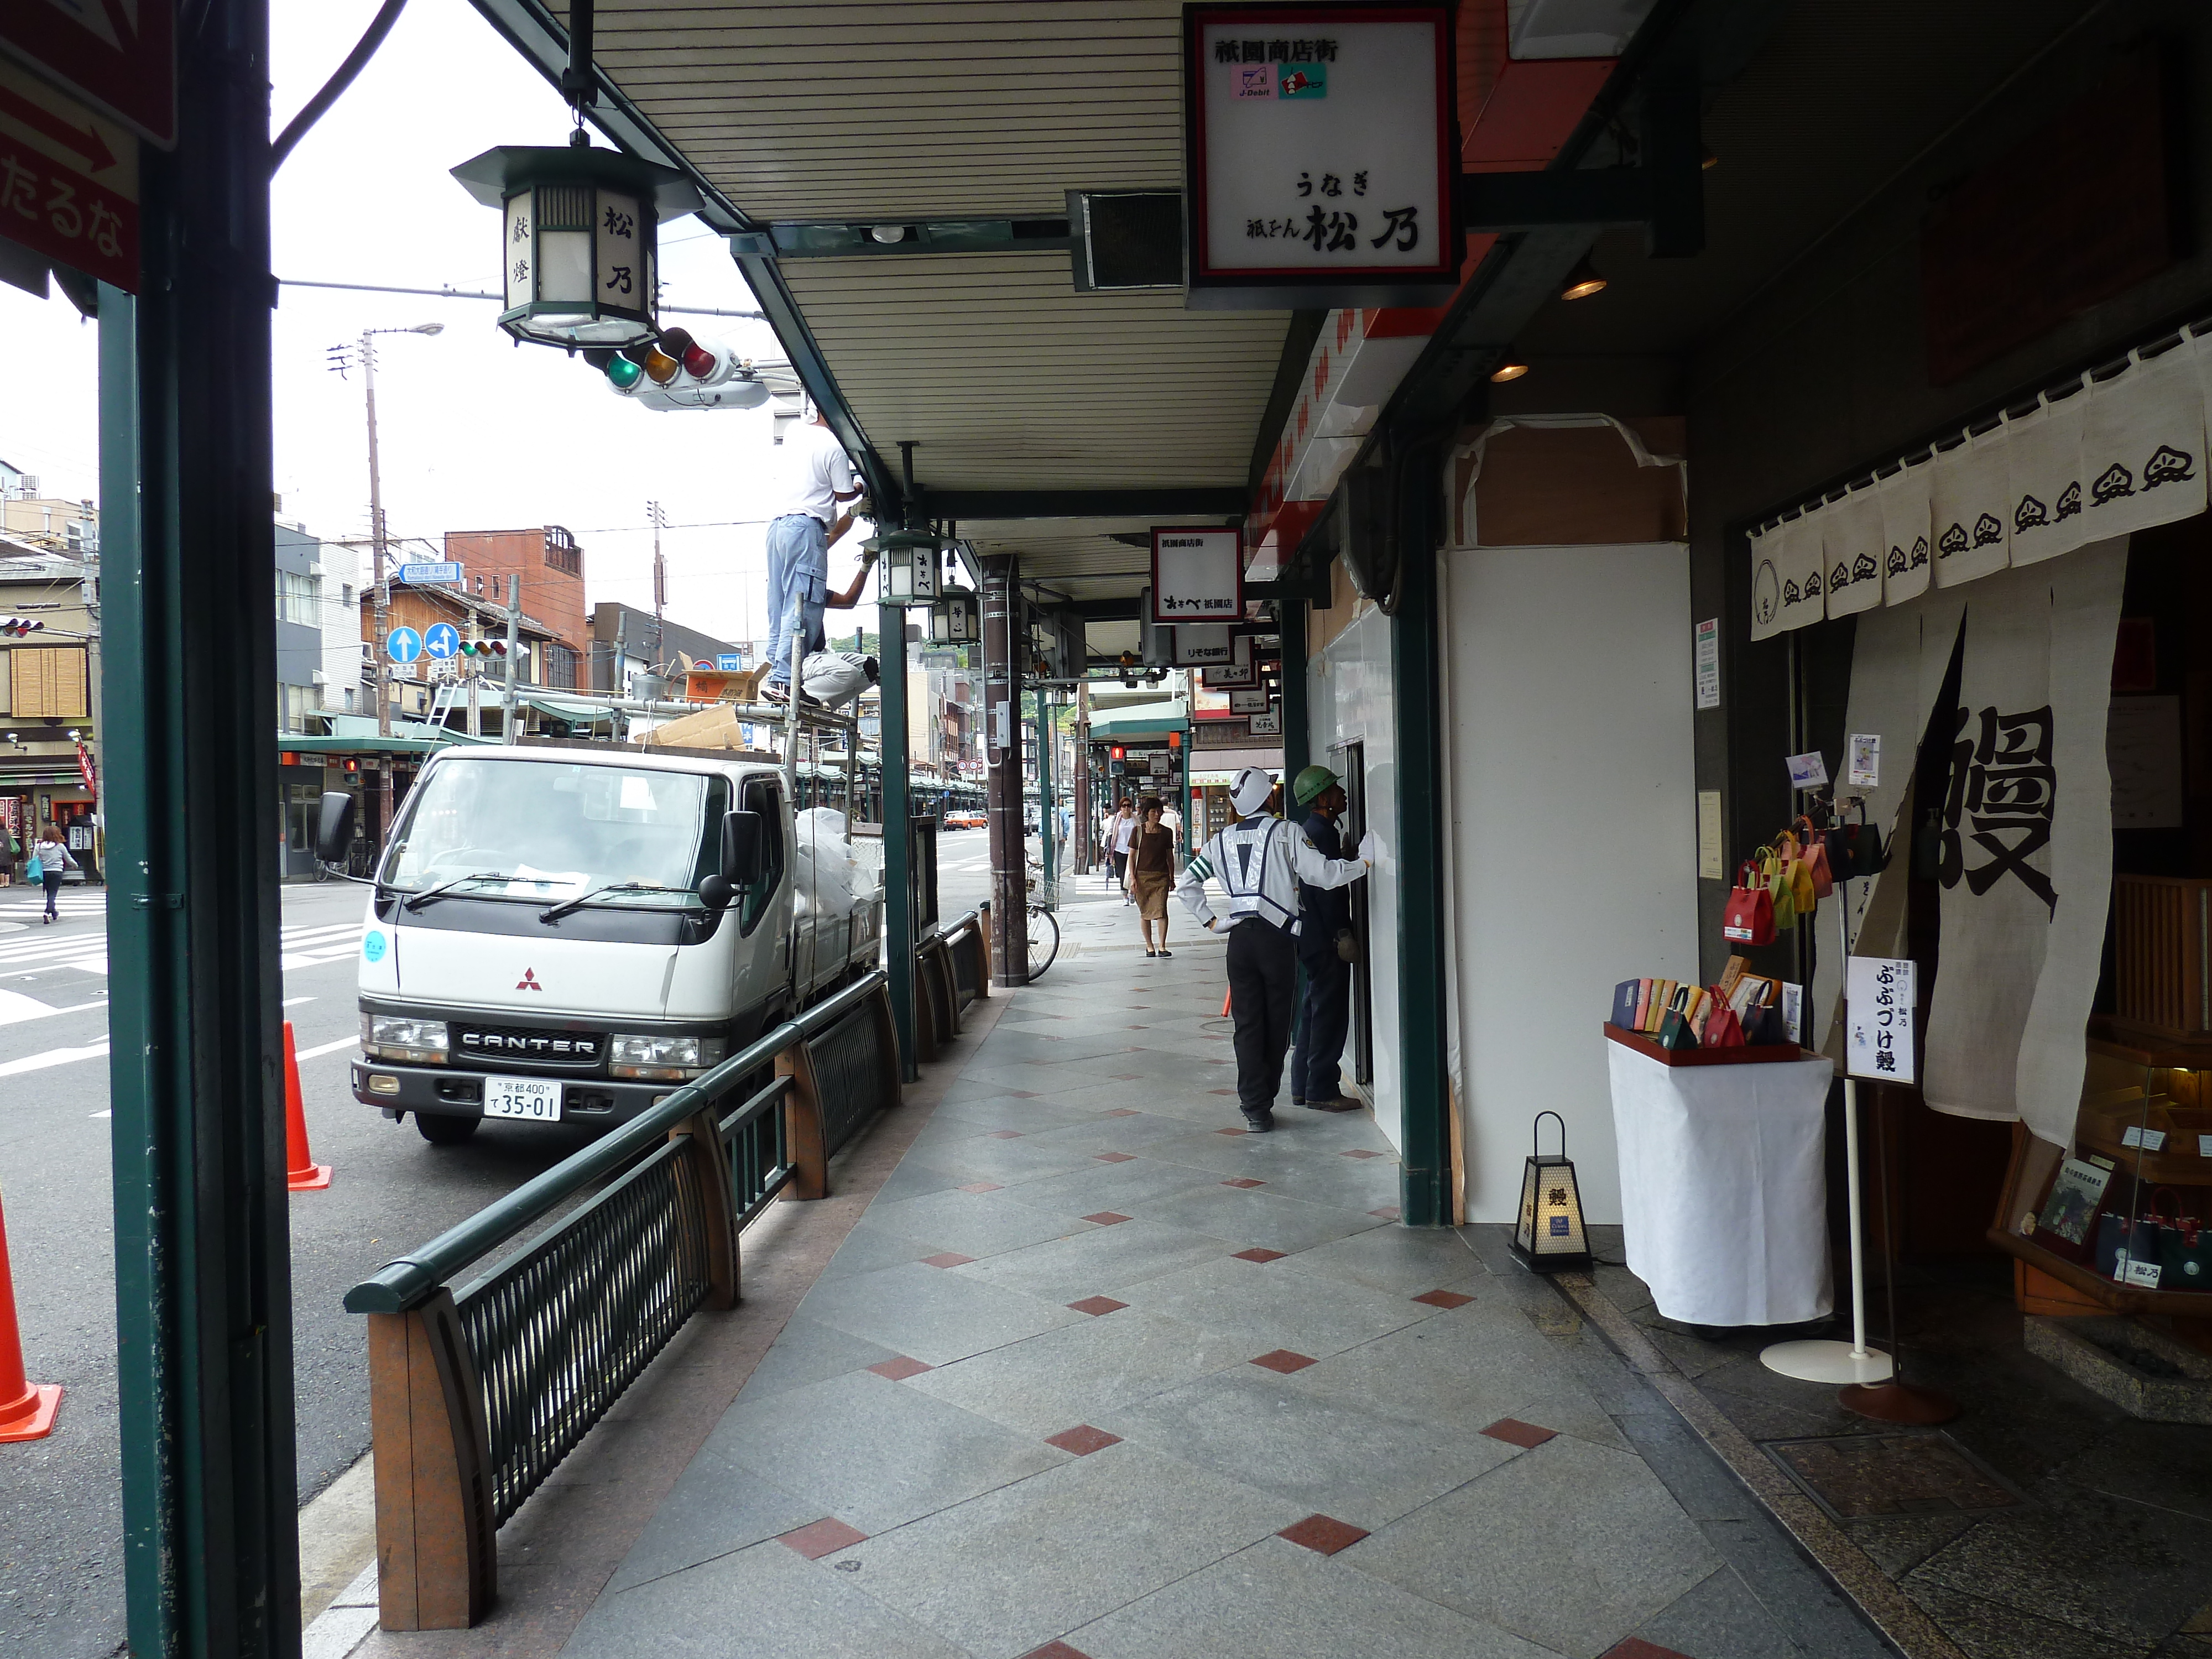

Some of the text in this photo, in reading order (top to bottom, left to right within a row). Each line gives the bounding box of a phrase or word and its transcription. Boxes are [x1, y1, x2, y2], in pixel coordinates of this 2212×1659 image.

[1297, 171, 1368, 197] うなぎ
[603, 206, 634, 294] 松乃
[1188, 647, 1228, 658] りそな銀行
[1876, 965, 1896, 1072] ぶぶづけ鰻
[462, 1034, 597, 1054] CANTER
[489, 1095, 554, 1118] て 35-01
[1548, 1188, 1567, 1206] 鰻
[2134, 1265, 2159, 1279] 松乃
